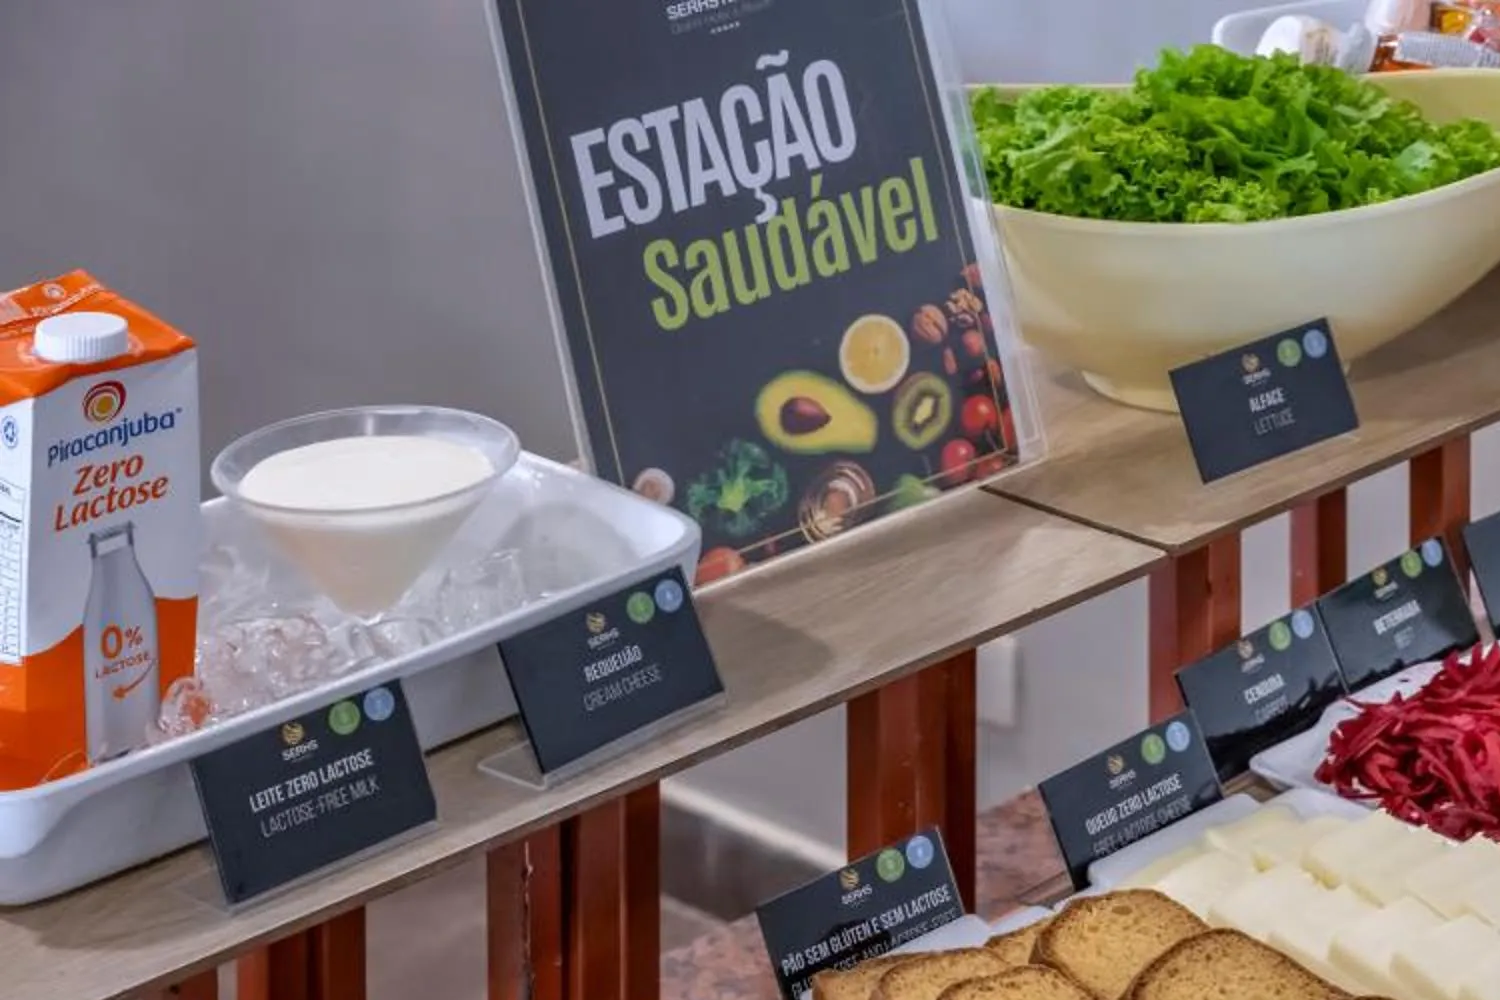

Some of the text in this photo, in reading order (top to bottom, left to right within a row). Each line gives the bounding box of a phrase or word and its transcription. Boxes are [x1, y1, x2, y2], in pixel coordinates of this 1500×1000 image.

[570, 49, 858, 239] ESTAÇÃO
[643, 157, 938, 331] Saudável
[1247, 387, 1285, 412] ALFACE
[47, 411, 177, 467] Piracanjuba
[72, 454, 144, 496] Zero
[54, 476, 169, 532] Lactose
[101, 624, 143, 659] 0%
[582, 642, 643, 683] REQUEIJÃO
[582, 663, 662, 711] CREAM CHEESE
[281, 739, 318, 760] SERHS
[249, 748, 374, 811] LEITE ZERO LACTOSE
[259, 774, 379, 837] LACTOSE-FREE MILK
[1115, 793, 1143, 818] ZERO
[1140, 772, 1182, 805] LACTOSE
[780, 949, 805, 976] PÃO
[804, 940, 829, 964] SEM
[871, 916, 881, 932] E
[879, 905, 904, 930] SEM
[904, 883, 951, 920] LACTOSE
